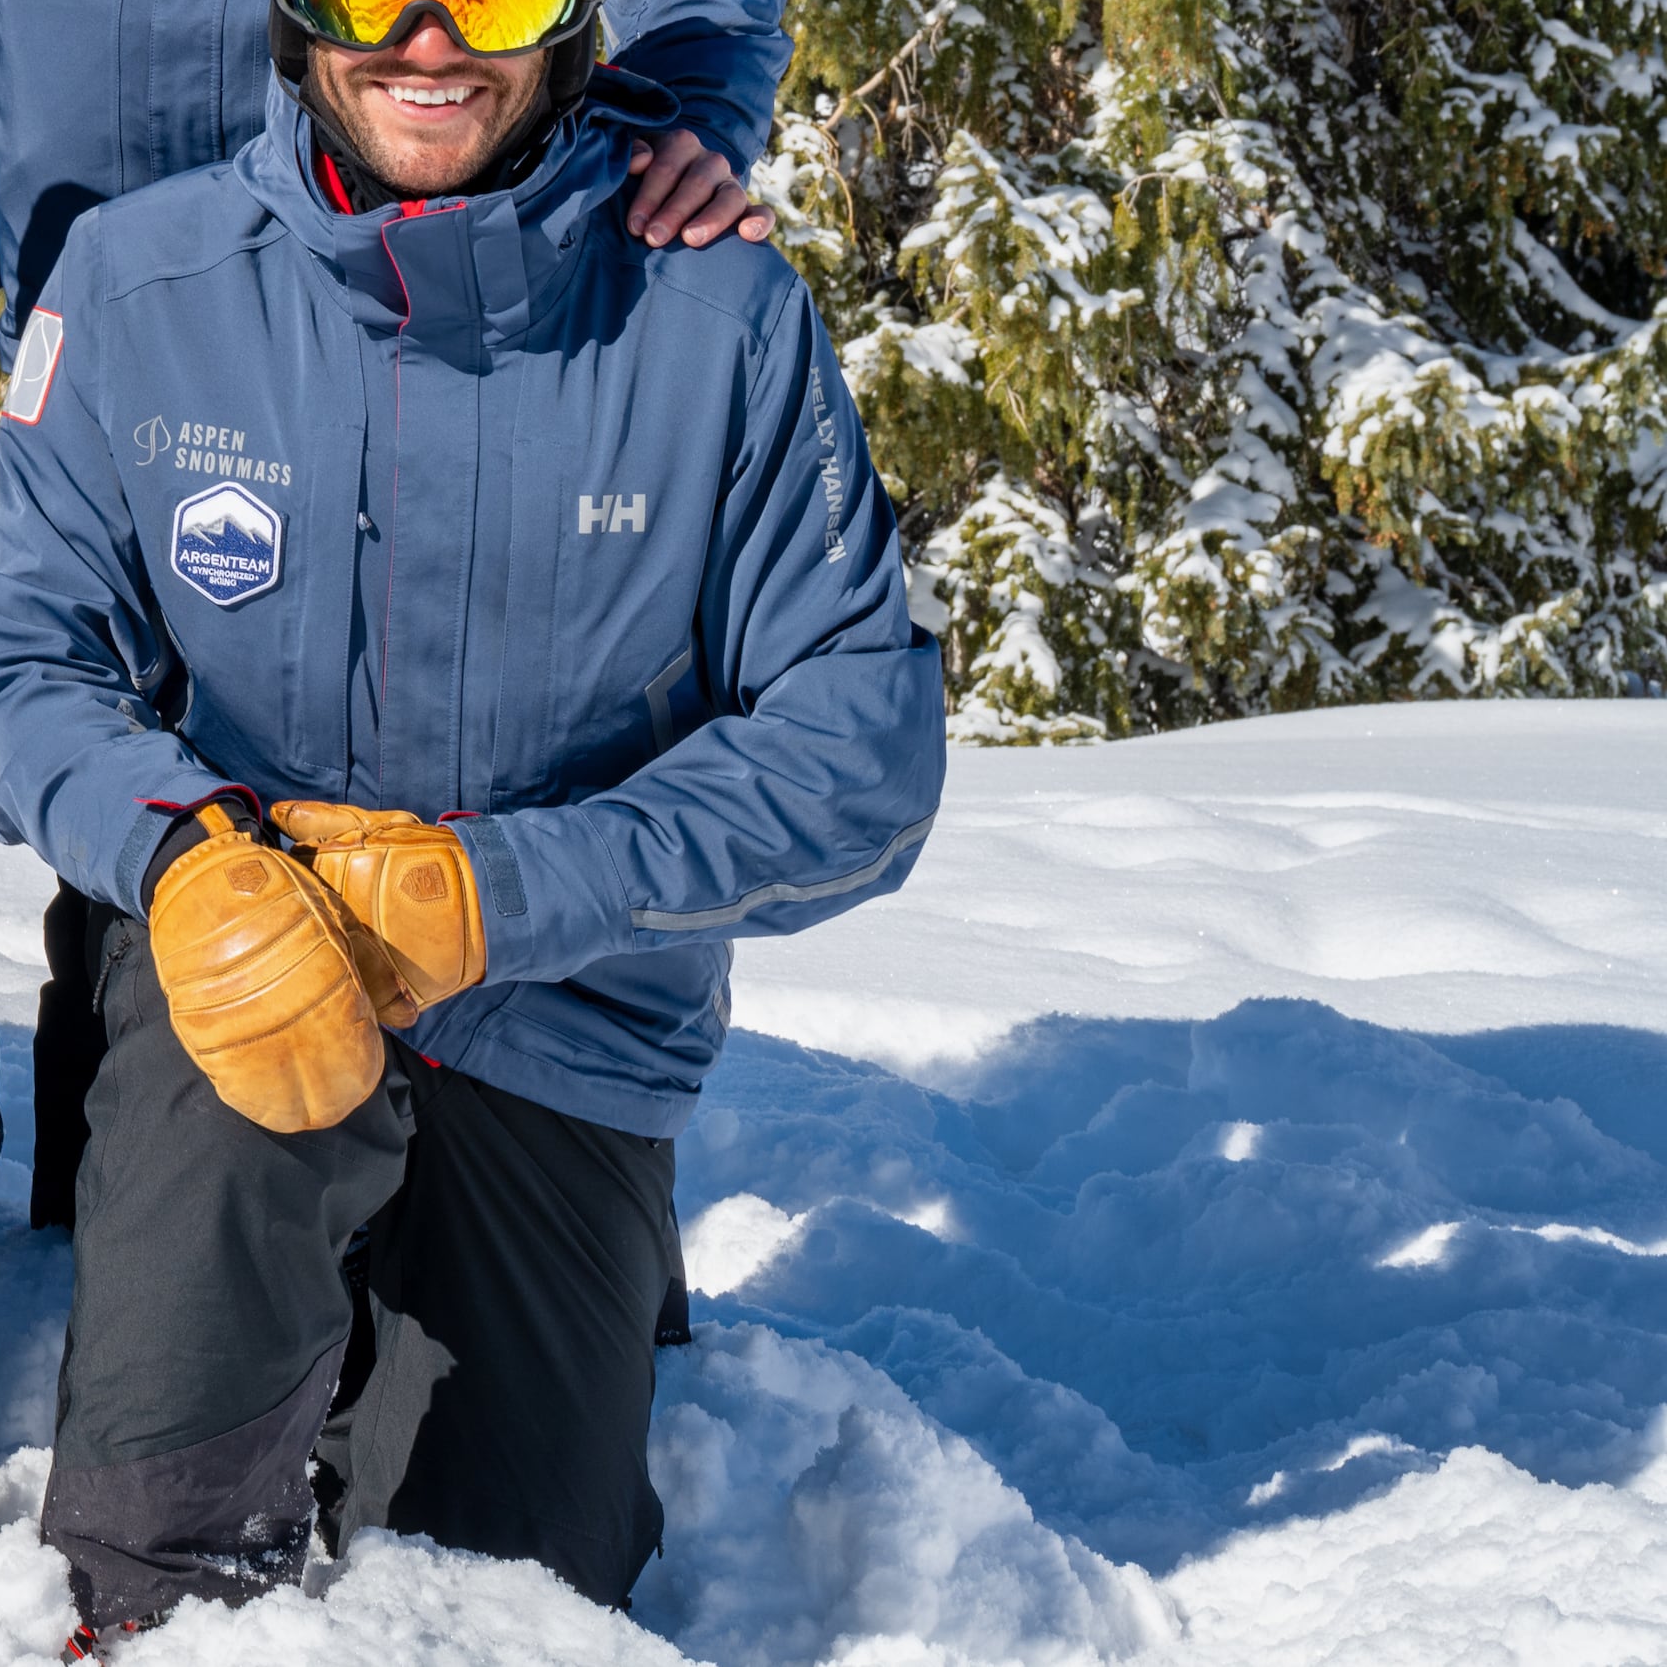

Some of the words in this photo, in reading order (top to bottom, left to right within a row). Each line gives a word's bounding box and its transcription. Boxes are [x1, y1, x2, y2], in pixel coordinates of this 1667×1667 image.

[810, 366, 836, 448] HELLY
[178, 421, 246, 452] ASPEN
[174, 447, 292, 486] SNOWMASS
[578, 493, 646, 534] HH
[819, 455, 847, 564] HANSEN
[180, 550, 270, 574] ARGENTEAM
[192, 565, 255, 582] SYNCHRONIZED
